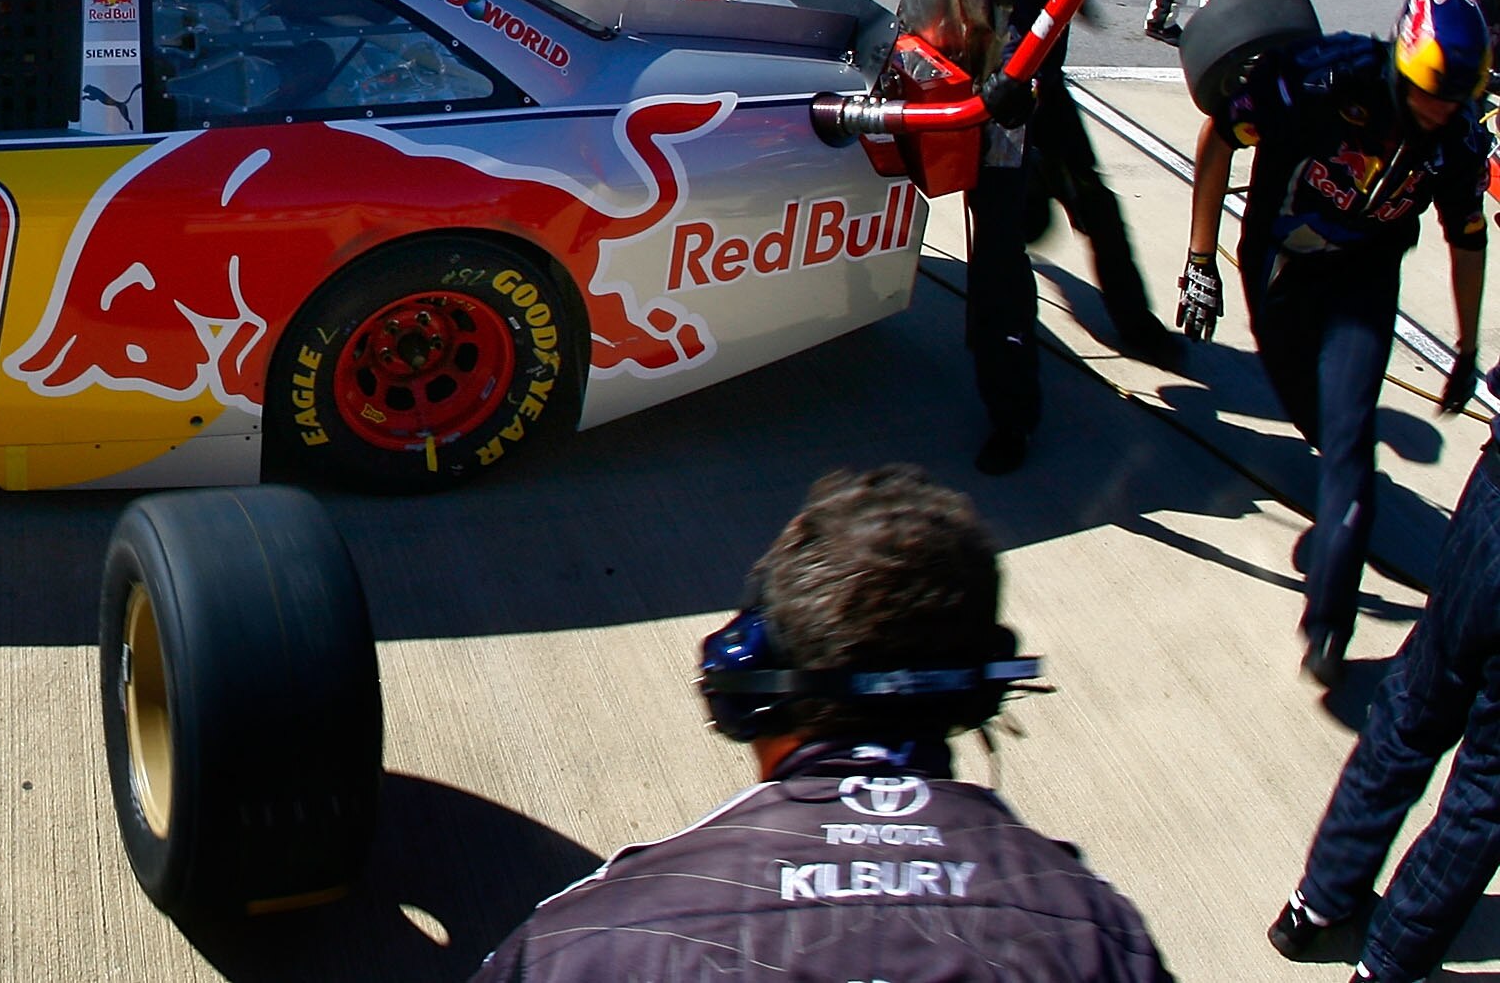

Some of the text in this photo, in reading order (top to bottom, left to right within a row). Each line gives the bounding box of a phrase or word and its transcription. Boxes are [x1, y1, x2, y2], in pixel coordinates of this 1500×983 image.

[90, 9, 135, 19] Red Bull
[483, 5, 571, 69] WORLD
[86, 49, 137, 58] SIEMENS
[1304, 160, 1357, 211] Red
[667, 182, 916, 291] Red Bull
[475, 269, 562, 466] GOODYEAR
[292, 345, 330, 446] EAGLE
[820, 824, 945, 847] TOYOTA
[781, 861, 978, 900] KILBURY
